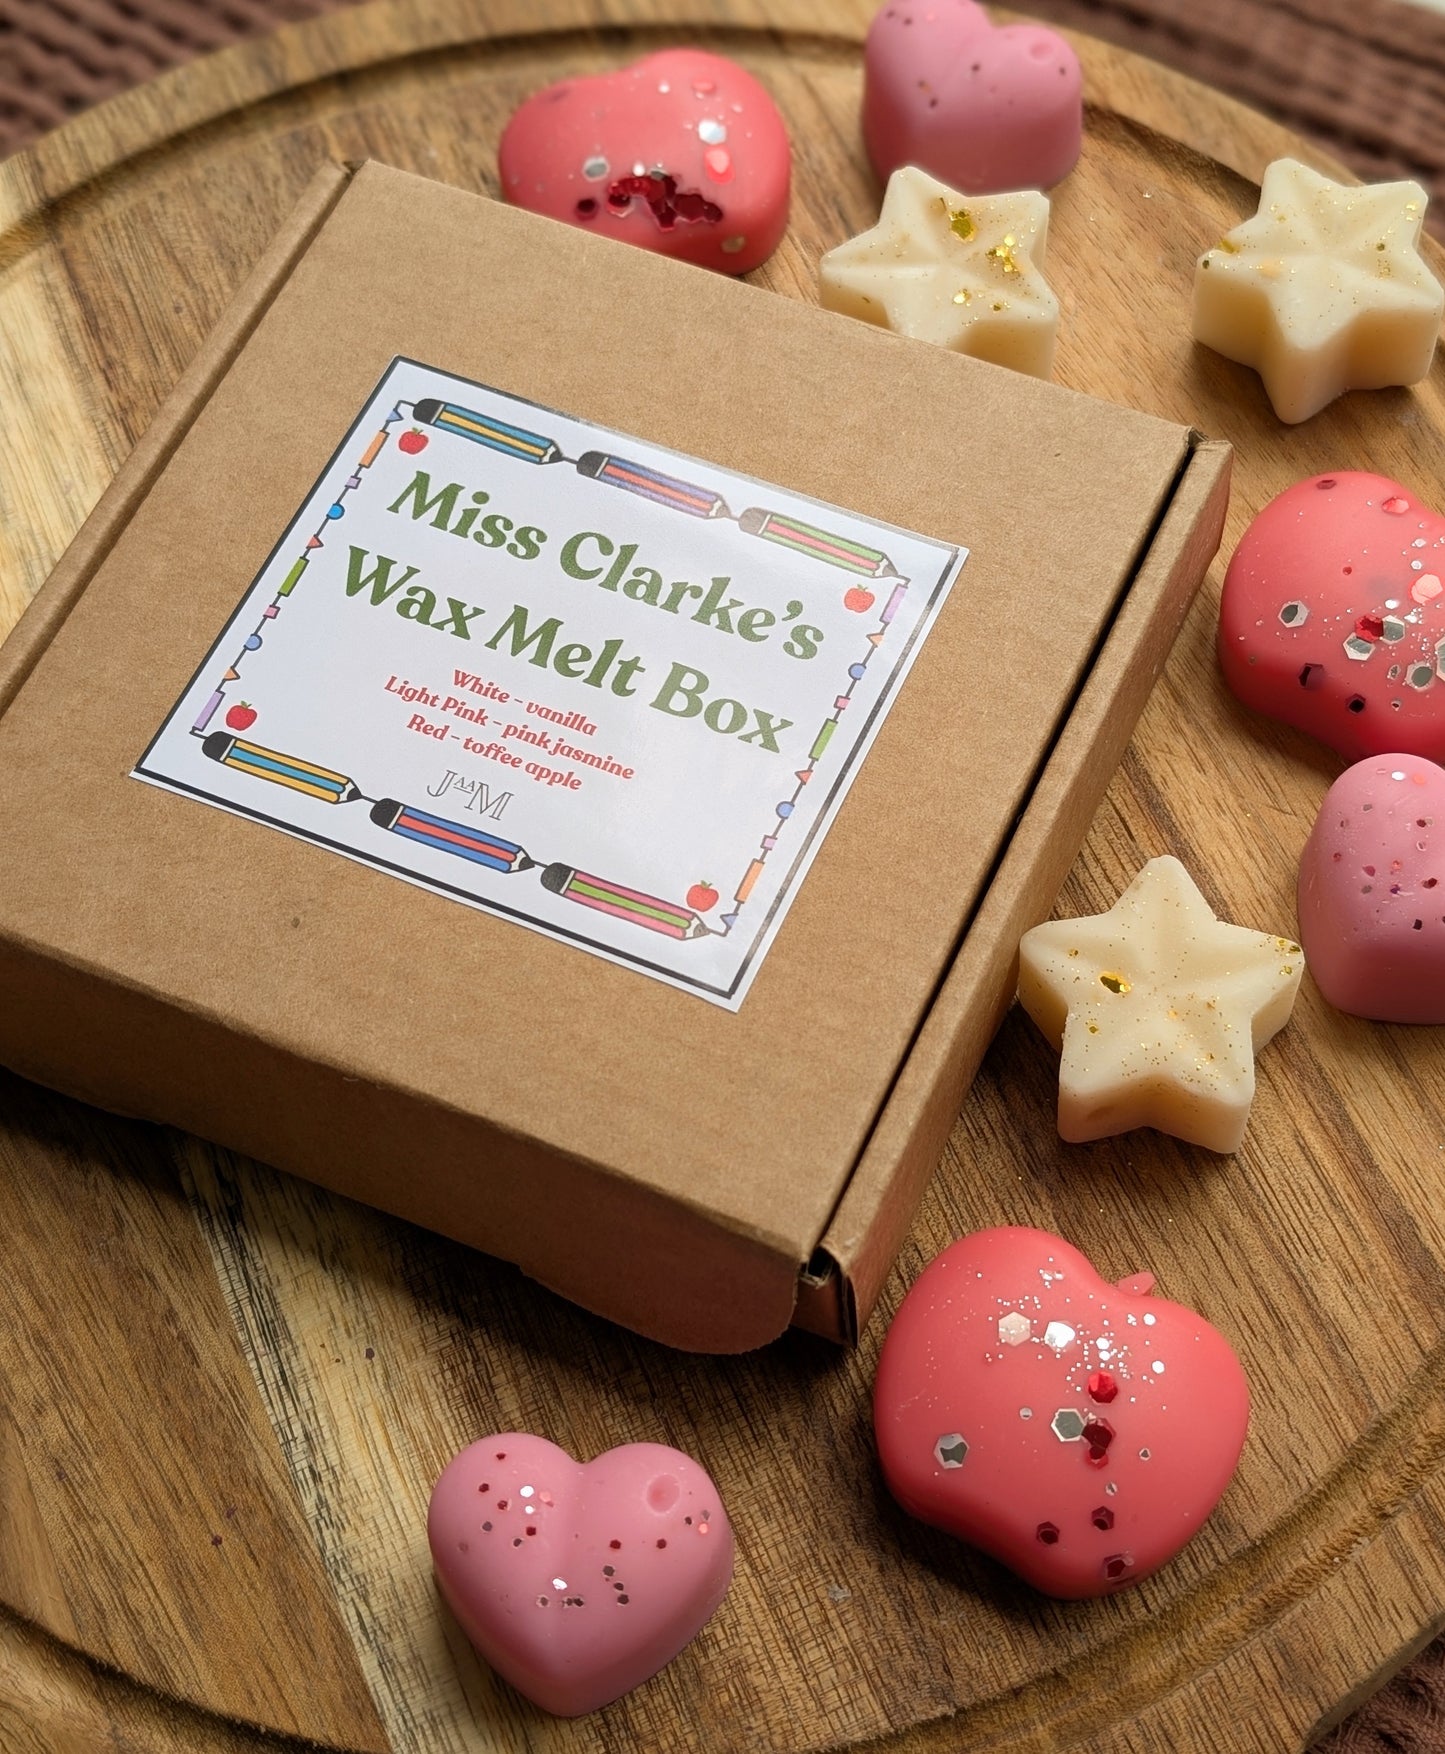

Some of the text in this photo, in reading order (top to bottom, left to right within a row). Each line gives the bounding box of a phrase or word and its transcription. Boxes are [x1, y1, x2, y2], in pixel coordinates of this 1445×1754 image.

[386, 470, 548, 560] Miss
[345, 545, 796, 754] Wax Melt Box
[384, 675, 441, 708] Light
[440, 696, 489, 727] Pink
[501, 724, 552, 750] pink
[548, 738, 636, 780] jasmine
[453, 669, 511, 704] White
[525, 702, 598, 737] vanilla
[406, 713, 450, 741] Red
[463, 736, 523, 769] toffee
[525, 760, 583, 791] apple
